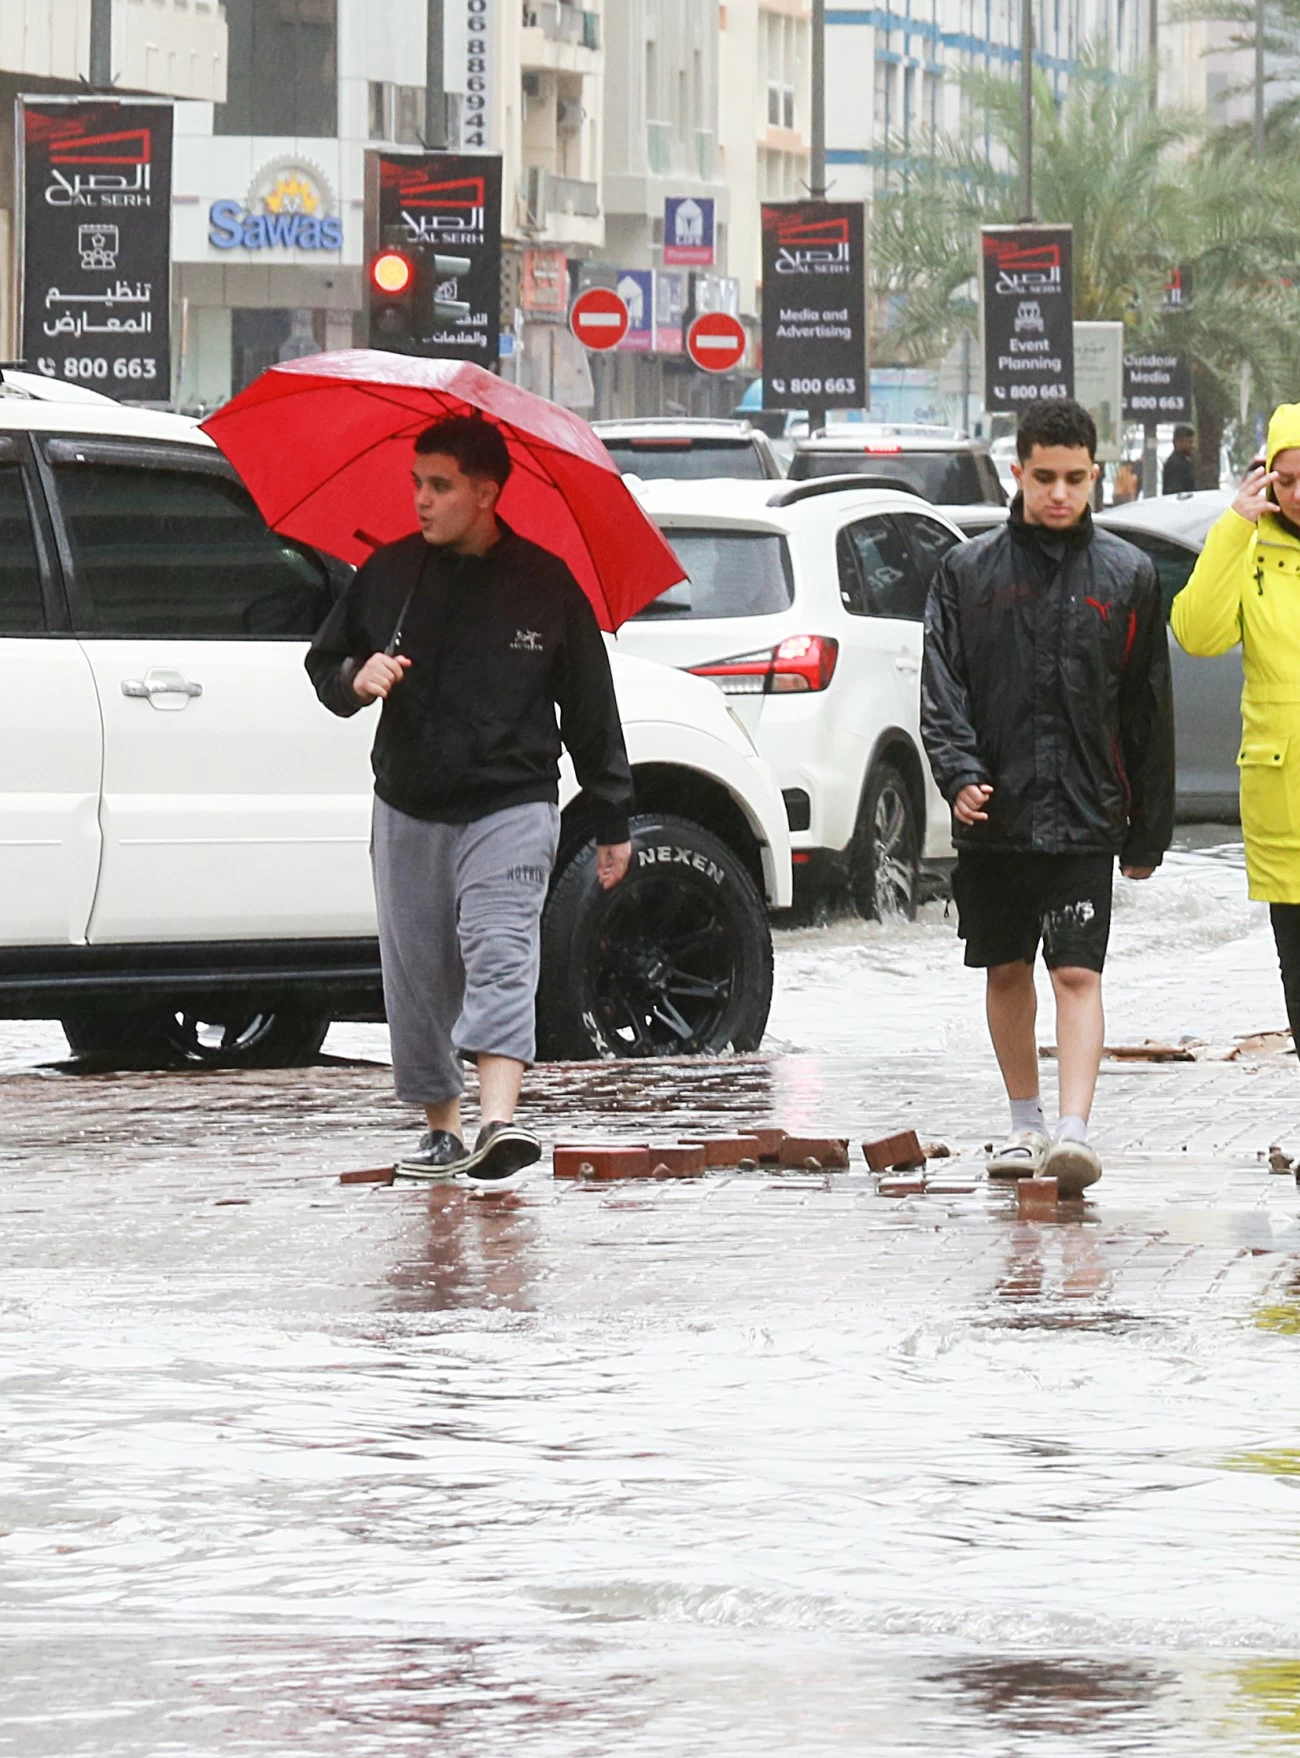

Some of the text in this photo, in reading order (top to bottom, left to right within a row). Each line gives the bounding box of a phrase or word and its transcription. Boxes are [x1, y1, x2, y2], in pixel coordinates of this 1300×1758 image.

[72, 194, 151, 207] AL SERH
[208, 199, 344, 251] Sawas
[442, 232, 485, 244] SERH
[814, 263, 850, 274] SERH
[44, 280, 152, 309] تنظيم
[779, 308, 848, 321] Media and
[43, 310, 152, 338] المعارض
[776, 325, 852, 341] Advertising
[1009, 338, 1050, 352] Event
[64, 357, 157, 379] 800 663
[998, 355, 1062, 373] Planning
[1130, 371, 1170, 384] Media
[791, 378, 857, 394] 800 663
[1010, 384, 1067, 400] 800 663
[1131, 396, 1184, 410] 800 663
[637, 846, 725, 885] NEXEN
